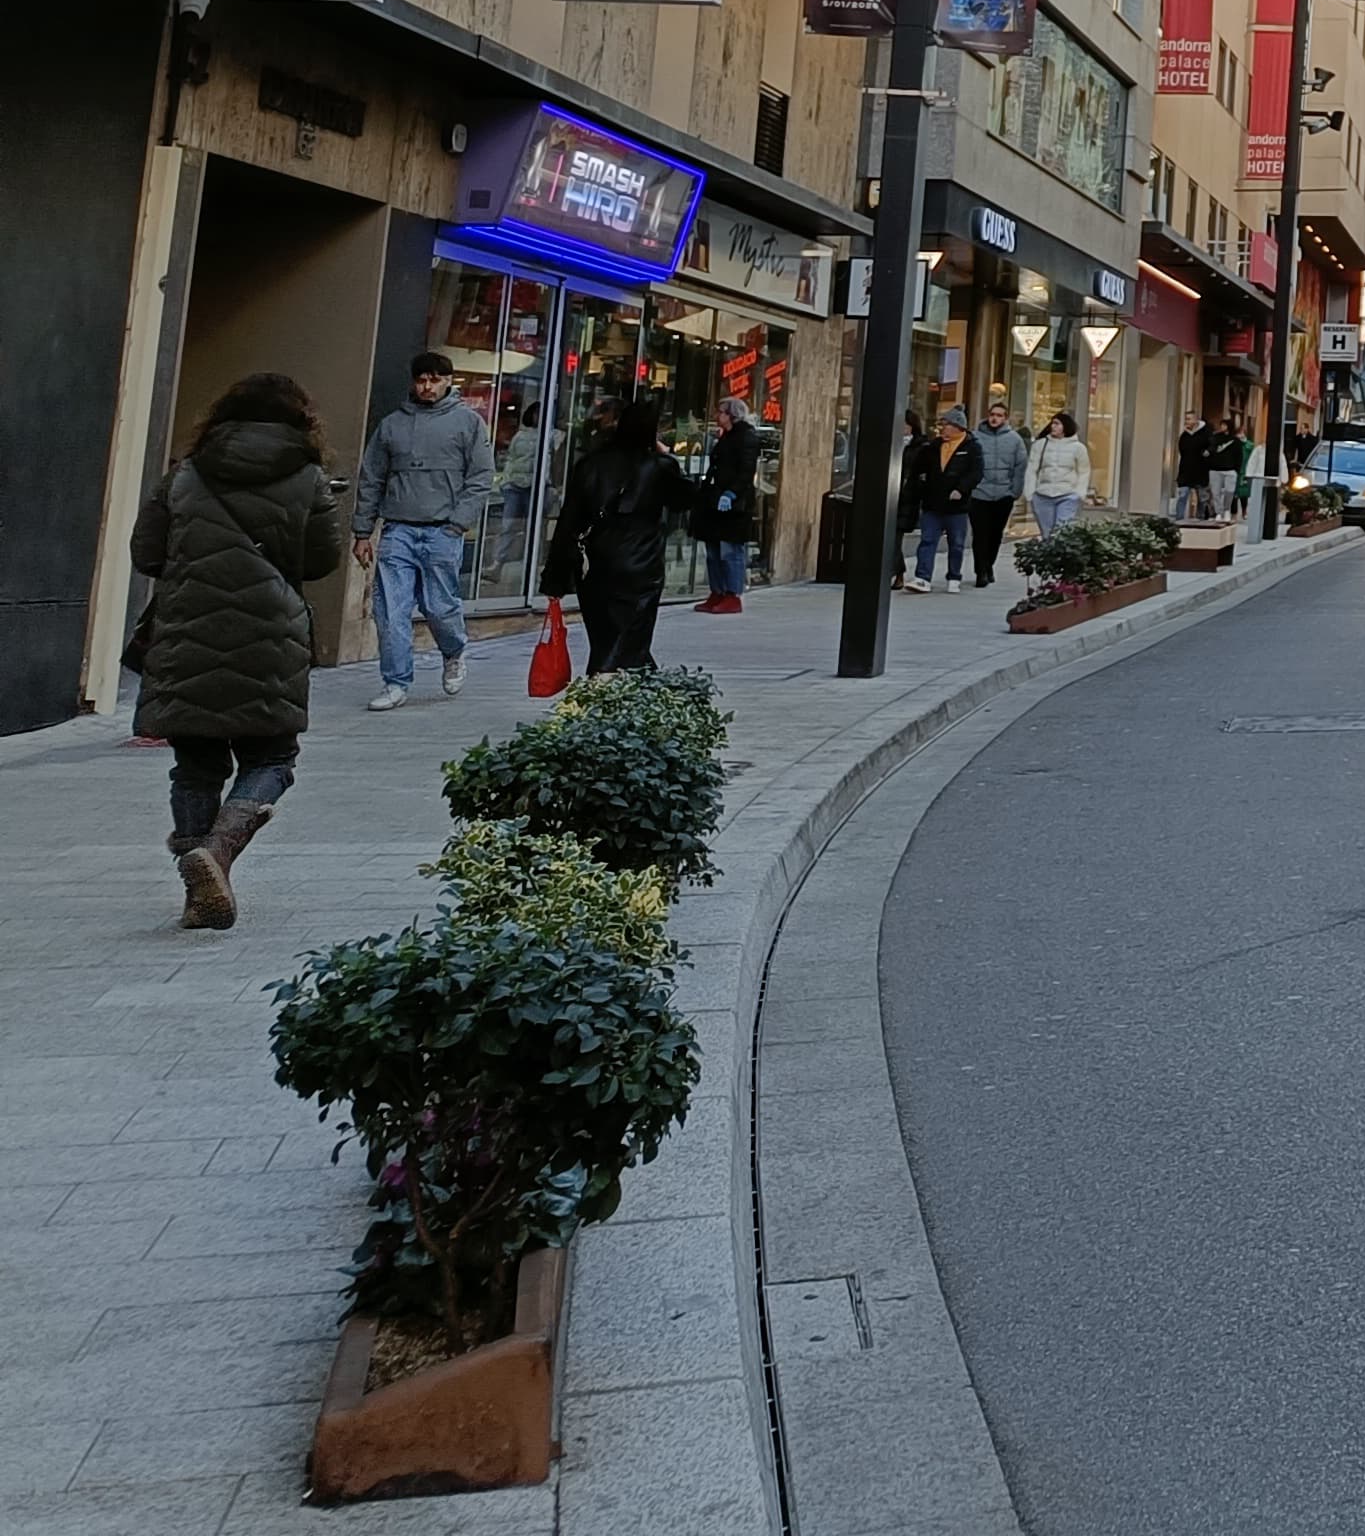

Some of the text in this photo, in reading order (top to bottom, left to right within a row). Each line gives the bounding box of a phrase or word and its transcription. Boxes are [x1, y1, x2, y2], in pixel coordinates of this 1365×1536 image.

[1160, 37, 1211, 52] andorra
[1159, 54, 1210, 69] palace
[1158, 71, 1208, 87] HOTEL
[1248, 133, 1286, 145] andorr
[1247, 147, 1285, 159] palac
[570, 150, 646, 197] SMASH
[562, 177, 638, 233] HIRO
[981, 208, 1017, 253] GUESS
[728, 222, 786, 287] Mystic
[1101, 269, 1126, 306] GUESS
[1332, 335, 1346, 350] H
